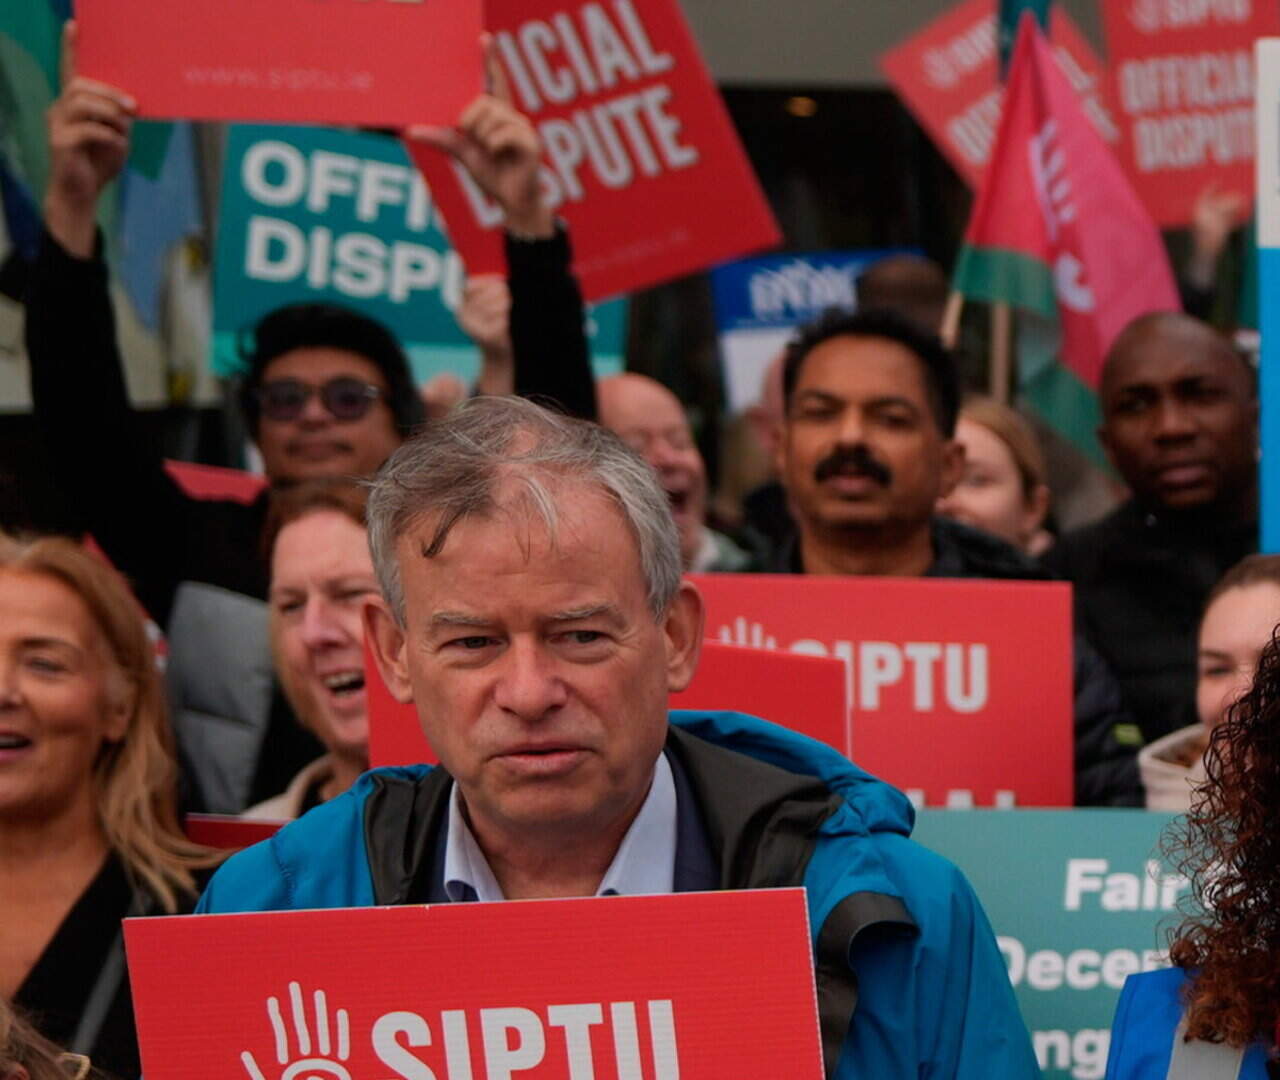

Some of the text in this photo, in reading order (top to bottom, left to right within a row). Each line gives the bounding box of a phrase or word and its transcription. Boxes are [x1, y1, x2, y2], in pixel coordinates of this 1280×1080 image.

[496, 0, 675, 113] ICIAL
[1119, 50, 1257, 116] OFFICIA
[1132, 106, 1257, 172] DISPUT
[241, 140, 440, 232] OFFI
[1064, 857, 1188, 912] Fair
